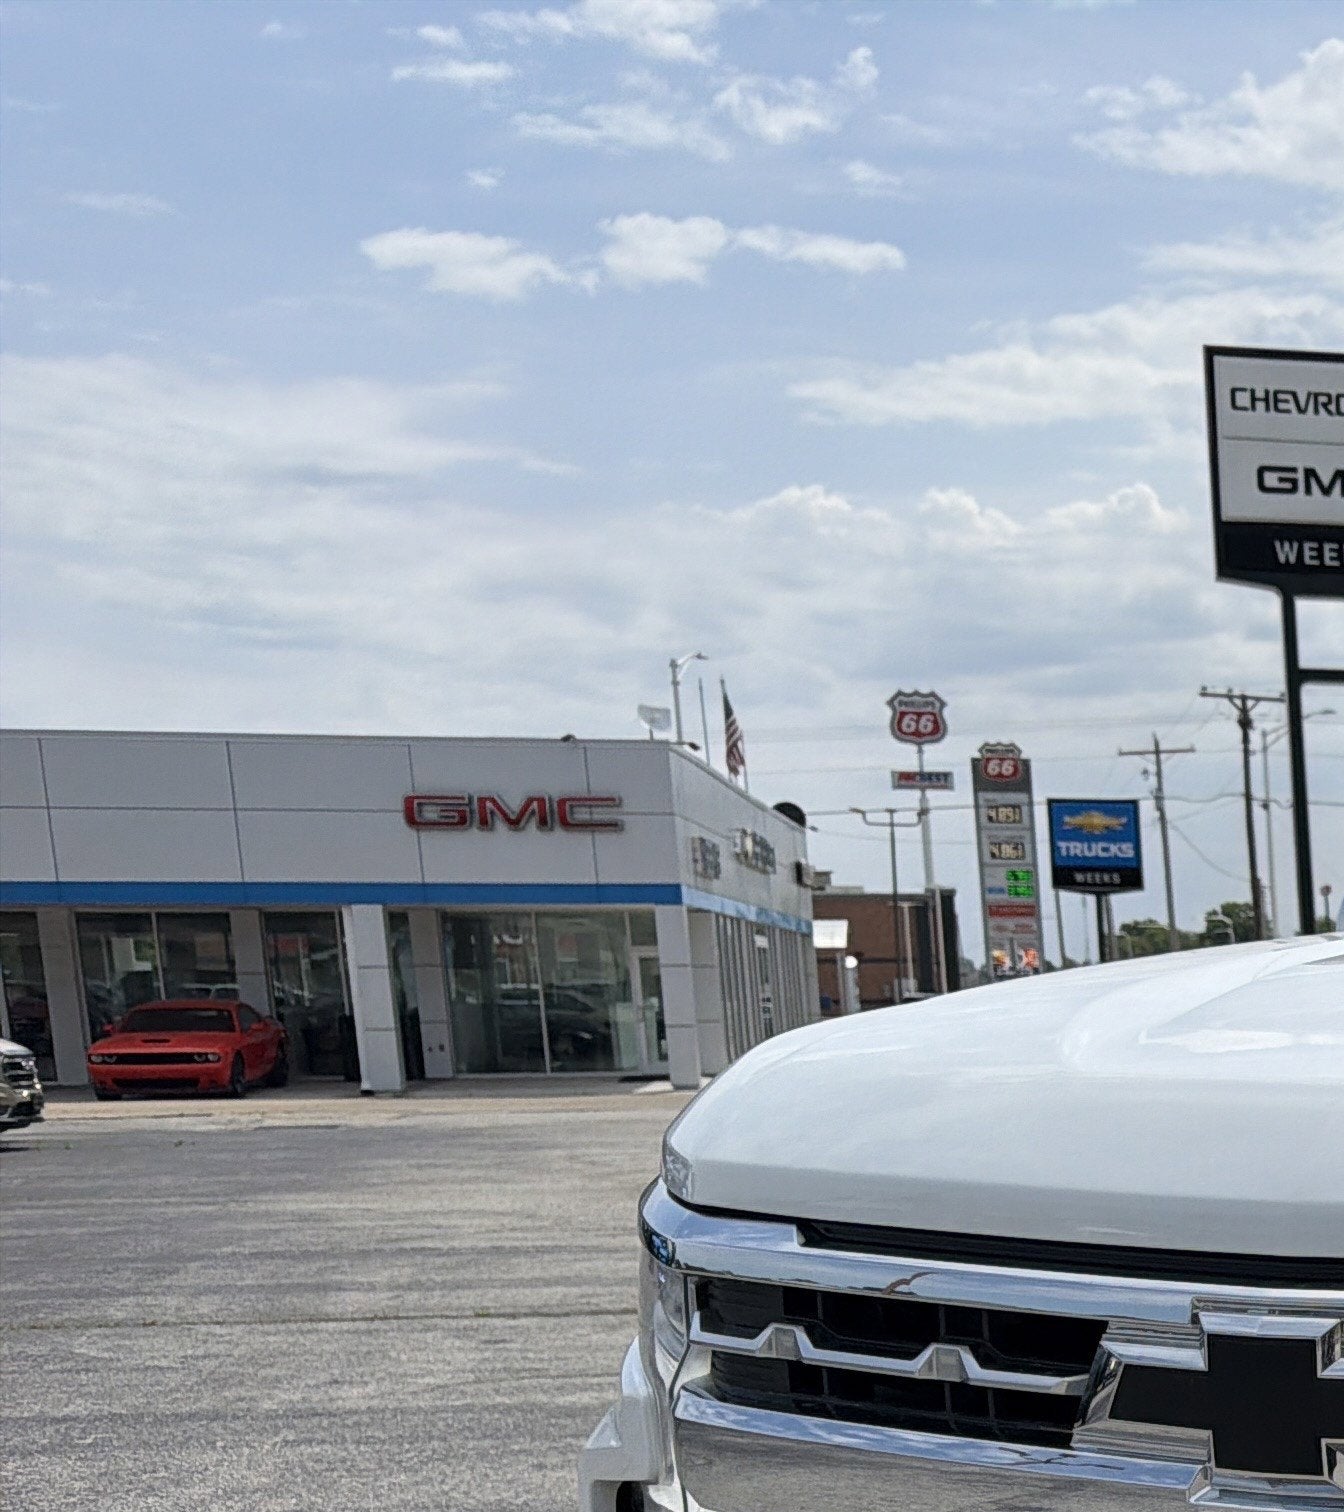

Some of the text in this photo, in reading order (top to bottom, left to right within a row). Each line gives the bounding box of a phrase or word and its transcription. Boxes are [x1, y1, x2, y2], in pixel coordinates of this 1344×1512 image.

[901, 713, 935, 734] 66
[987, 759, 1015, 776] 66
[403, 793, 626, 832] GMC
[1057, 841, 1135, 858] TRUCKS
[1073, 871, 1122, 884] WEEKS
